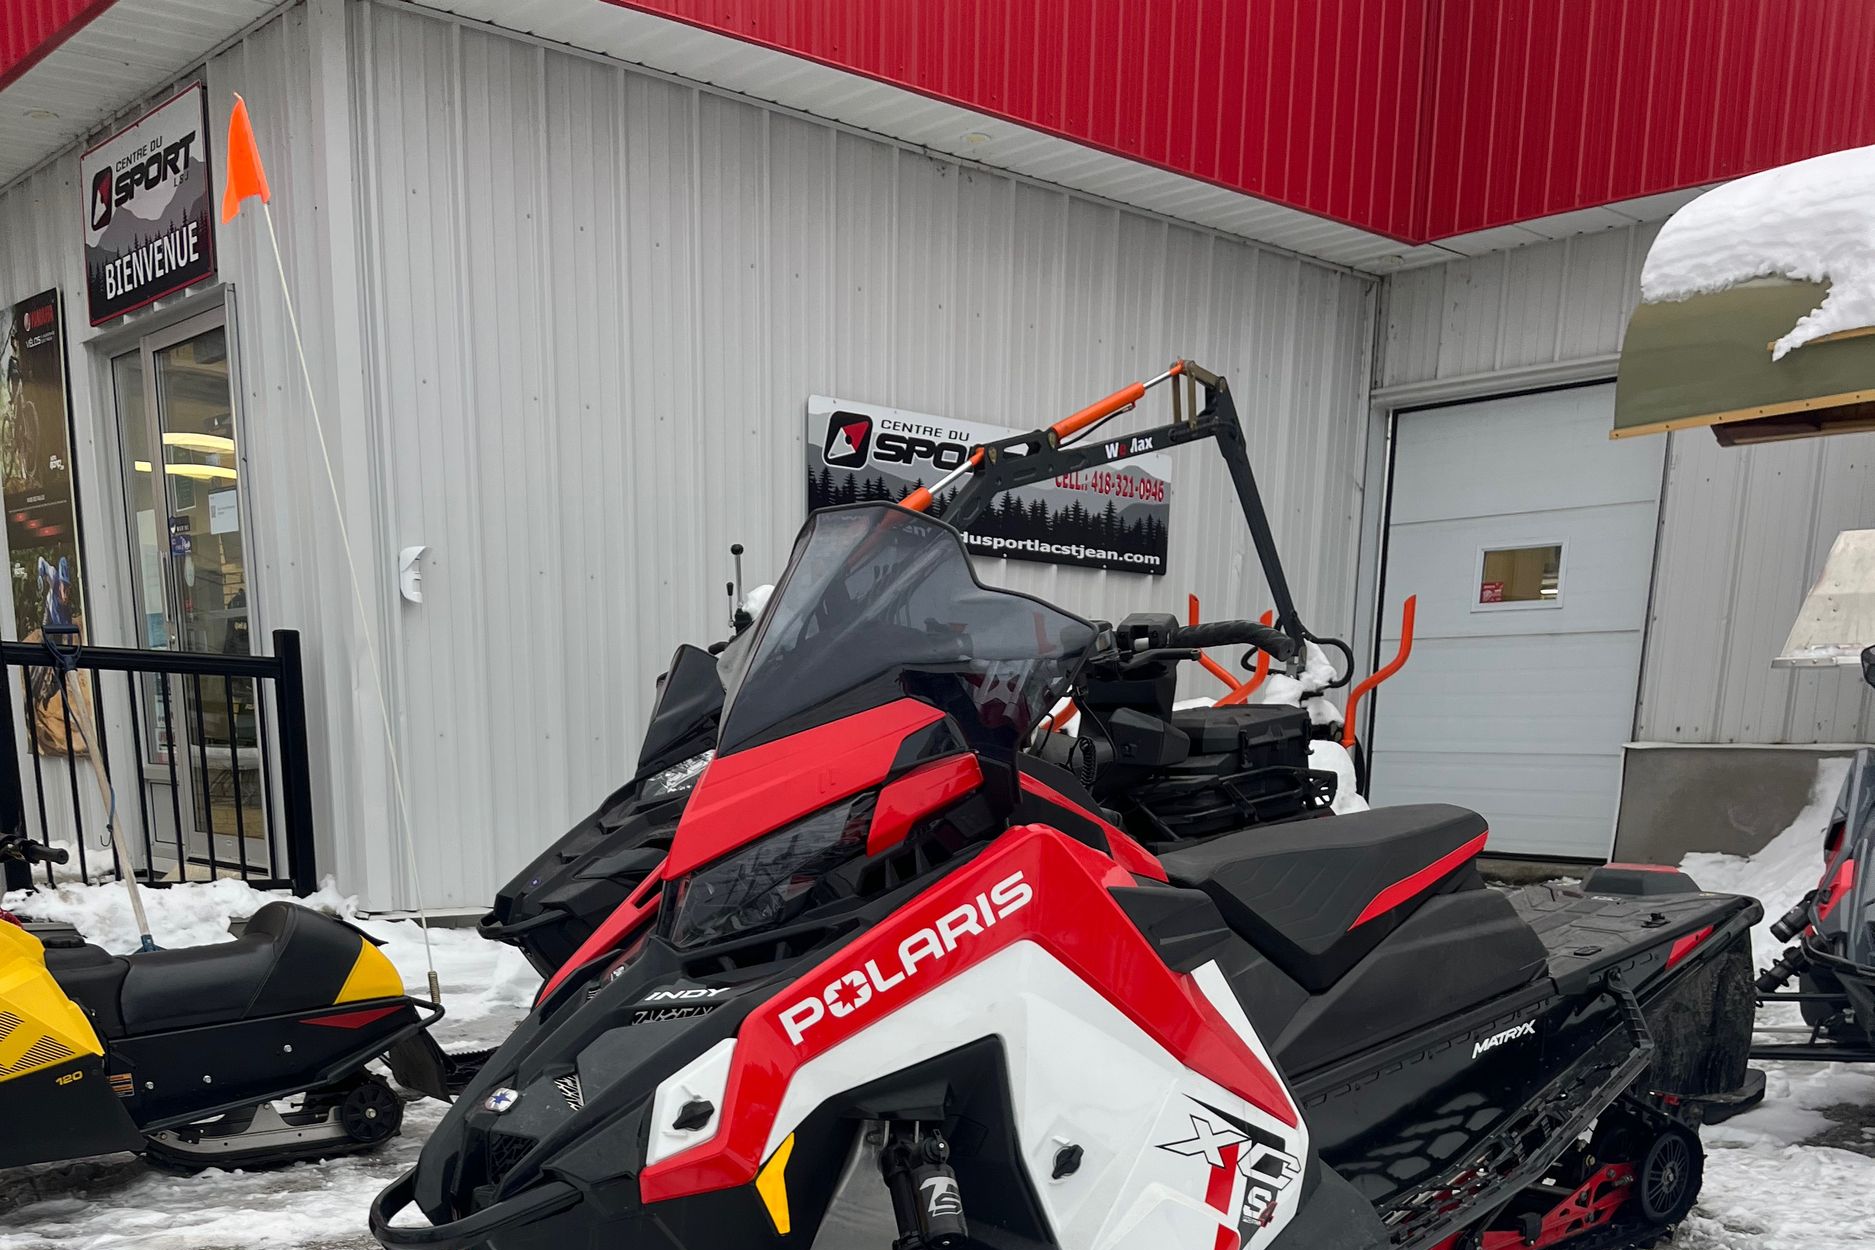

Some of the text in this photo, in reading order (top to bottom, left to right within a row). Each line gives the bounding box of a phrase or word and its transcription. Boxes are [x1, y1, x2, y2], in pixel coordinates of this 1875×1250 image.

[114, 130, 196, 208] SPORT
[115, 135, 163, 173] CENTRE DU
[104, 220, 200, 300] BIENVENUE
[880, 419, 970, 442] CENTRE DU
[872, 432, 976, 473] SPO
[1091, 469, 1165, 503] 418-321-0946
[778, 869, 1034, 1046] POLARIS
[644, 987, 731, 1001] INDY
[1471, 1018, 1537, 1060] MATRYX
[55, 1070, 84, 1086] 120
